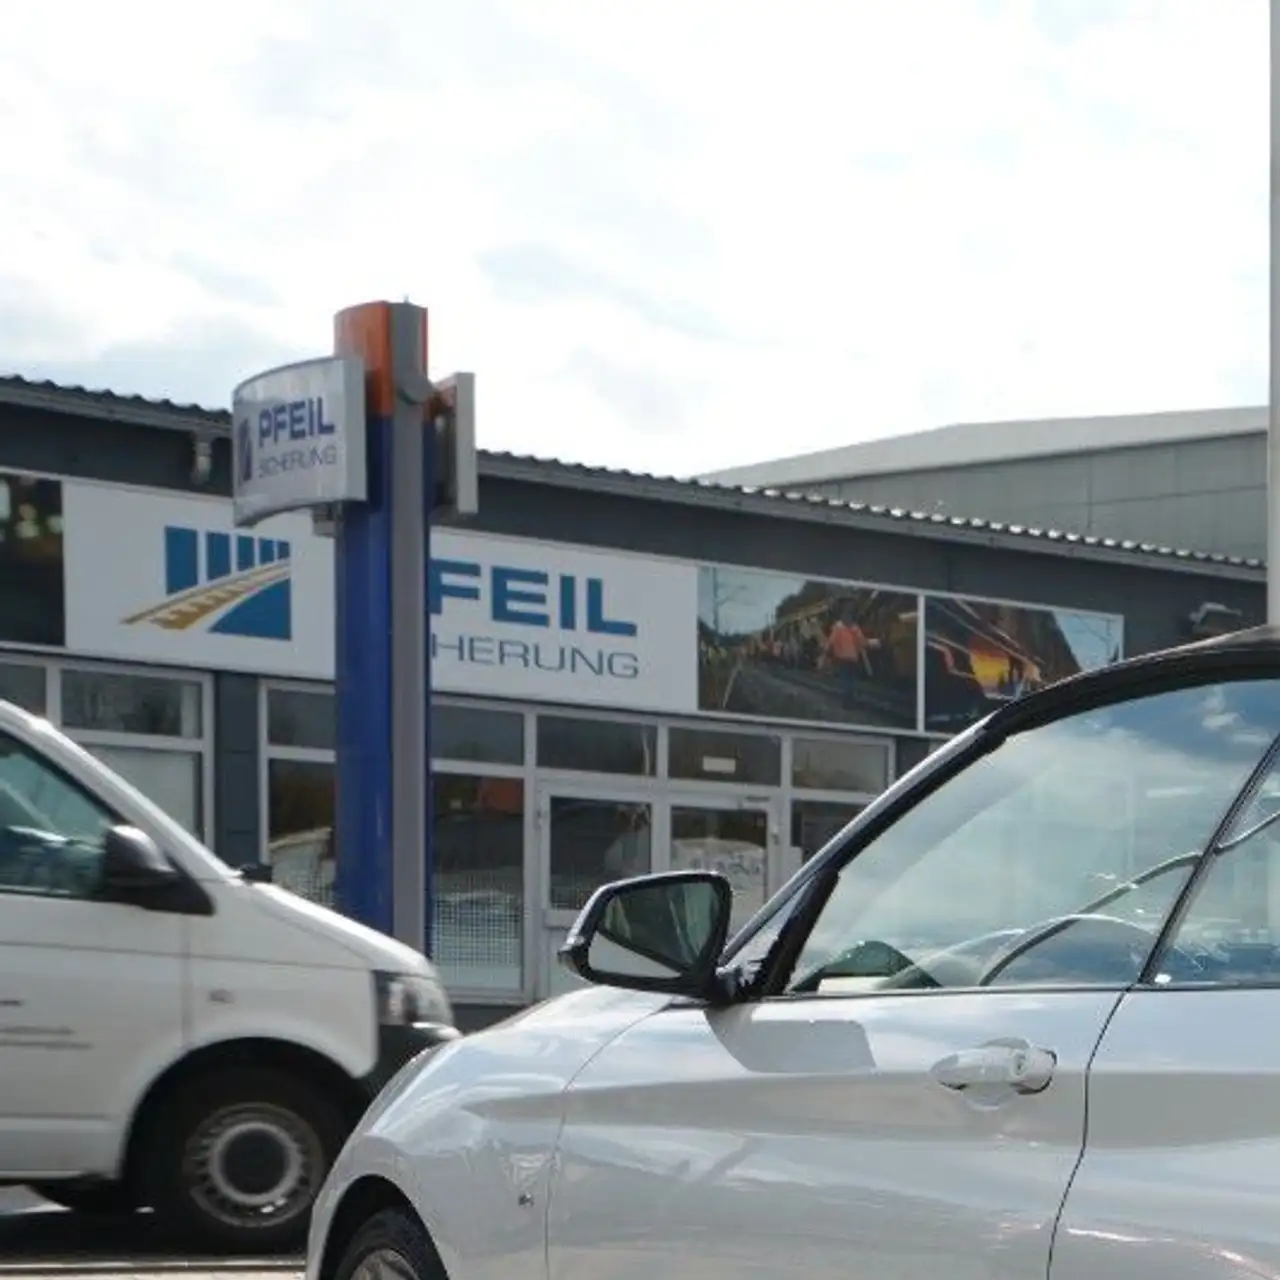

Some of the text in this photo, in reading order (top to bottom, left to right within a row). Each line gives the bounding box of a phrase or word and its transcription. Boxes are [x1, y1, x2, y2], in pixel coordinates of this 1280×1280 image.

[258, 396, 335, 449] PFEIL
[429, 558, 638, 637] FEIL
[432, 632, 640, 679] HERUNG
